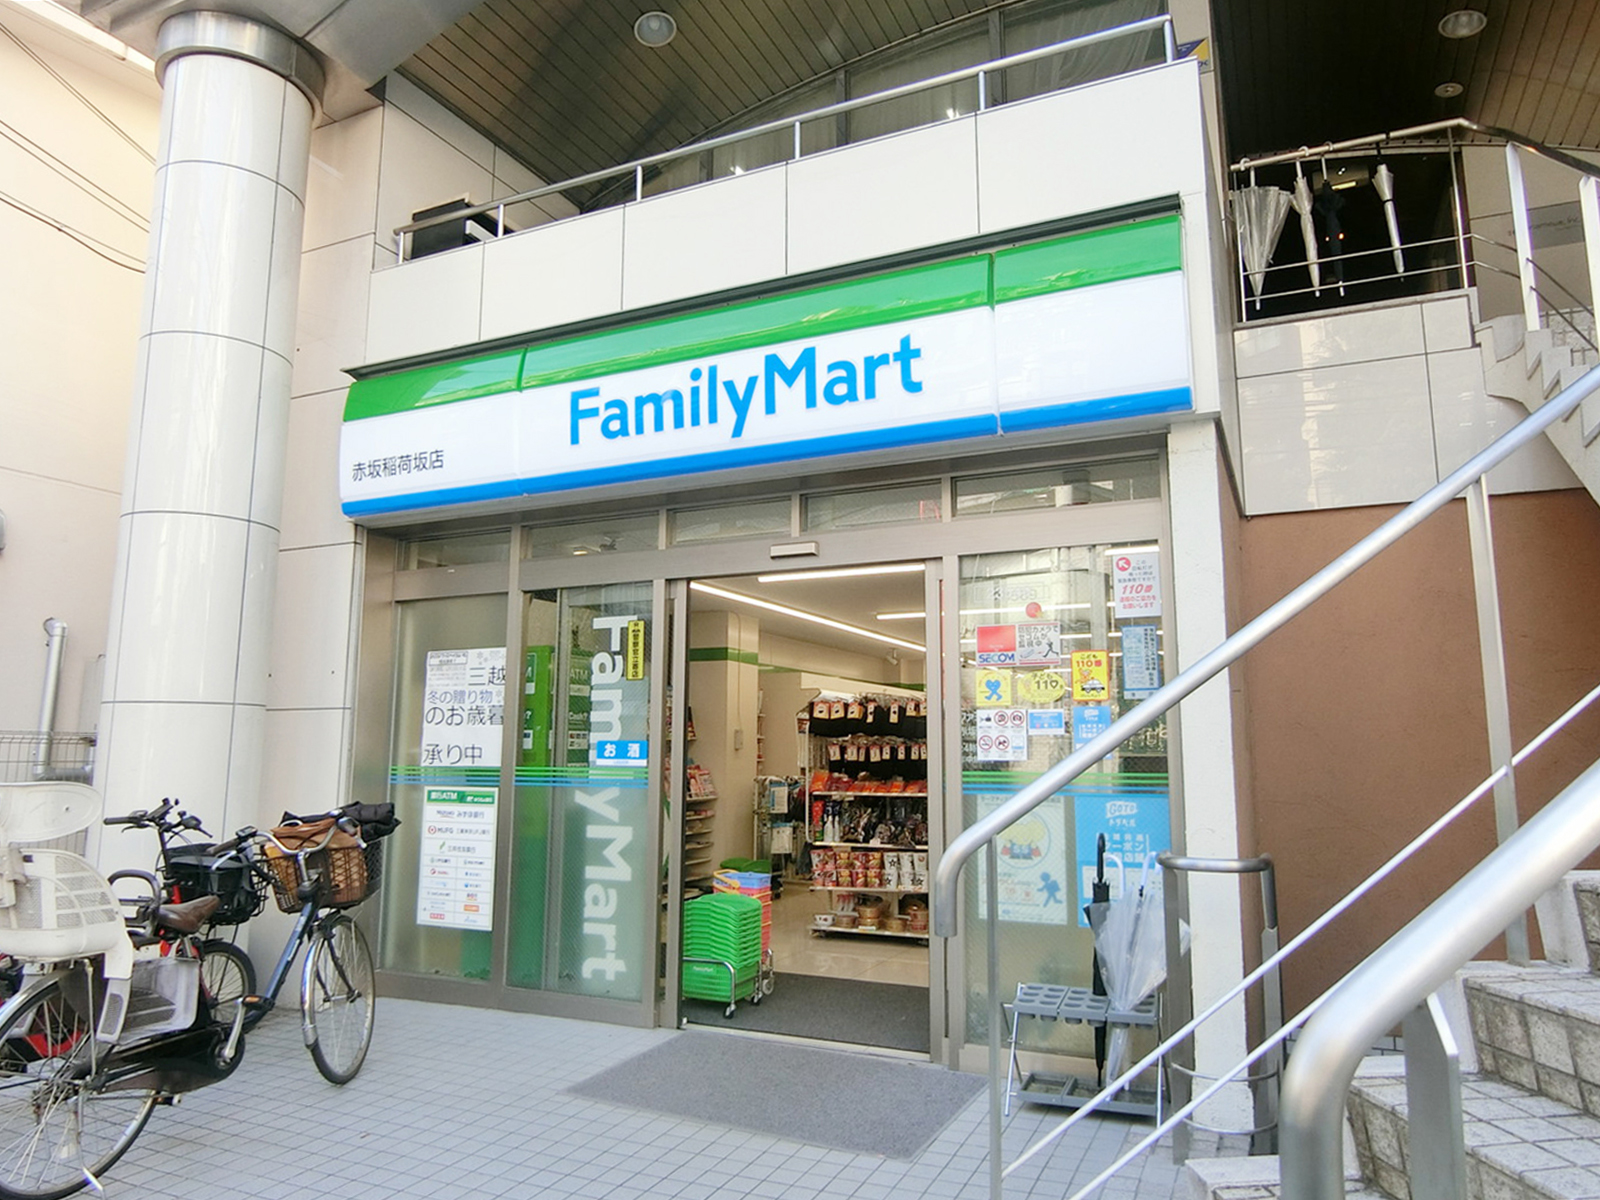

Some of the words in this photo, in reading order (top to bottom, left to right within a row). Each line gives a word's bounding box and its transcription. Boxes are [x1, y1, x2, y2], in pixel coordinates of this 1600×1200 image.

[570, 334, 923, 446] FamilyMart
[352, 449, 444, 482] 赤坂稲荷坂店
[978, 652, 1015, 664] SECOM
[468, 665, 506, 686] 三越
[427, 689, 493, 704] 冬の贈り物
[423, 744, 482, 765] 承り中
